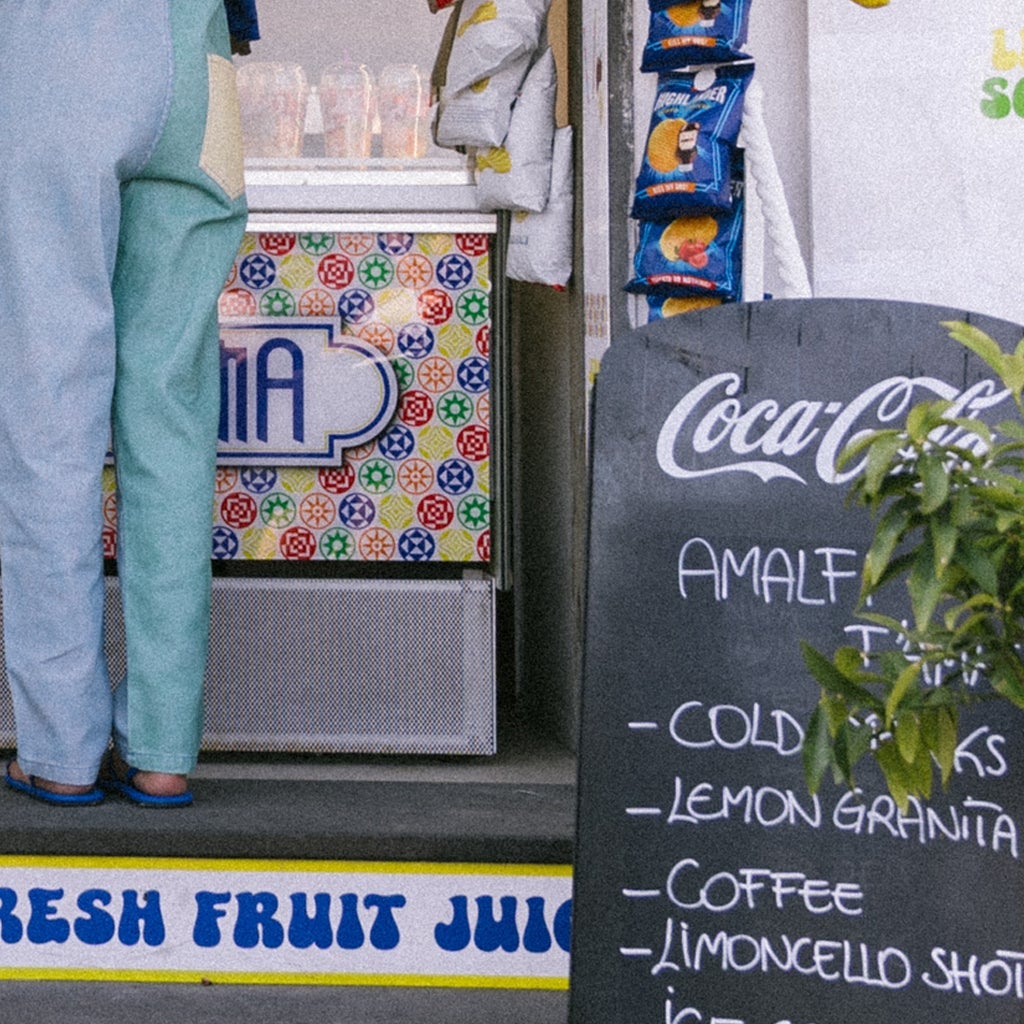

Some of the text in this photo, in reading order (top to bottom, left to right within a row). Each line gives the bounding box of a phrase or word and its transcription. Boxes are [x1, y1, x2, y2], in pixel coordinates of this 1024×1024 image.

[678, 537, 873, 607] AMALF
[669, 701, 805, 755] COLD
[668, 777, 821, 828] LEMON
[833, 788, 1019, 858] GRANITA
[666, 858, 864, 915] COFFEE
[193, 890, 406, 950] FRUIT
[922, 947, 1024, 999] SHOT
